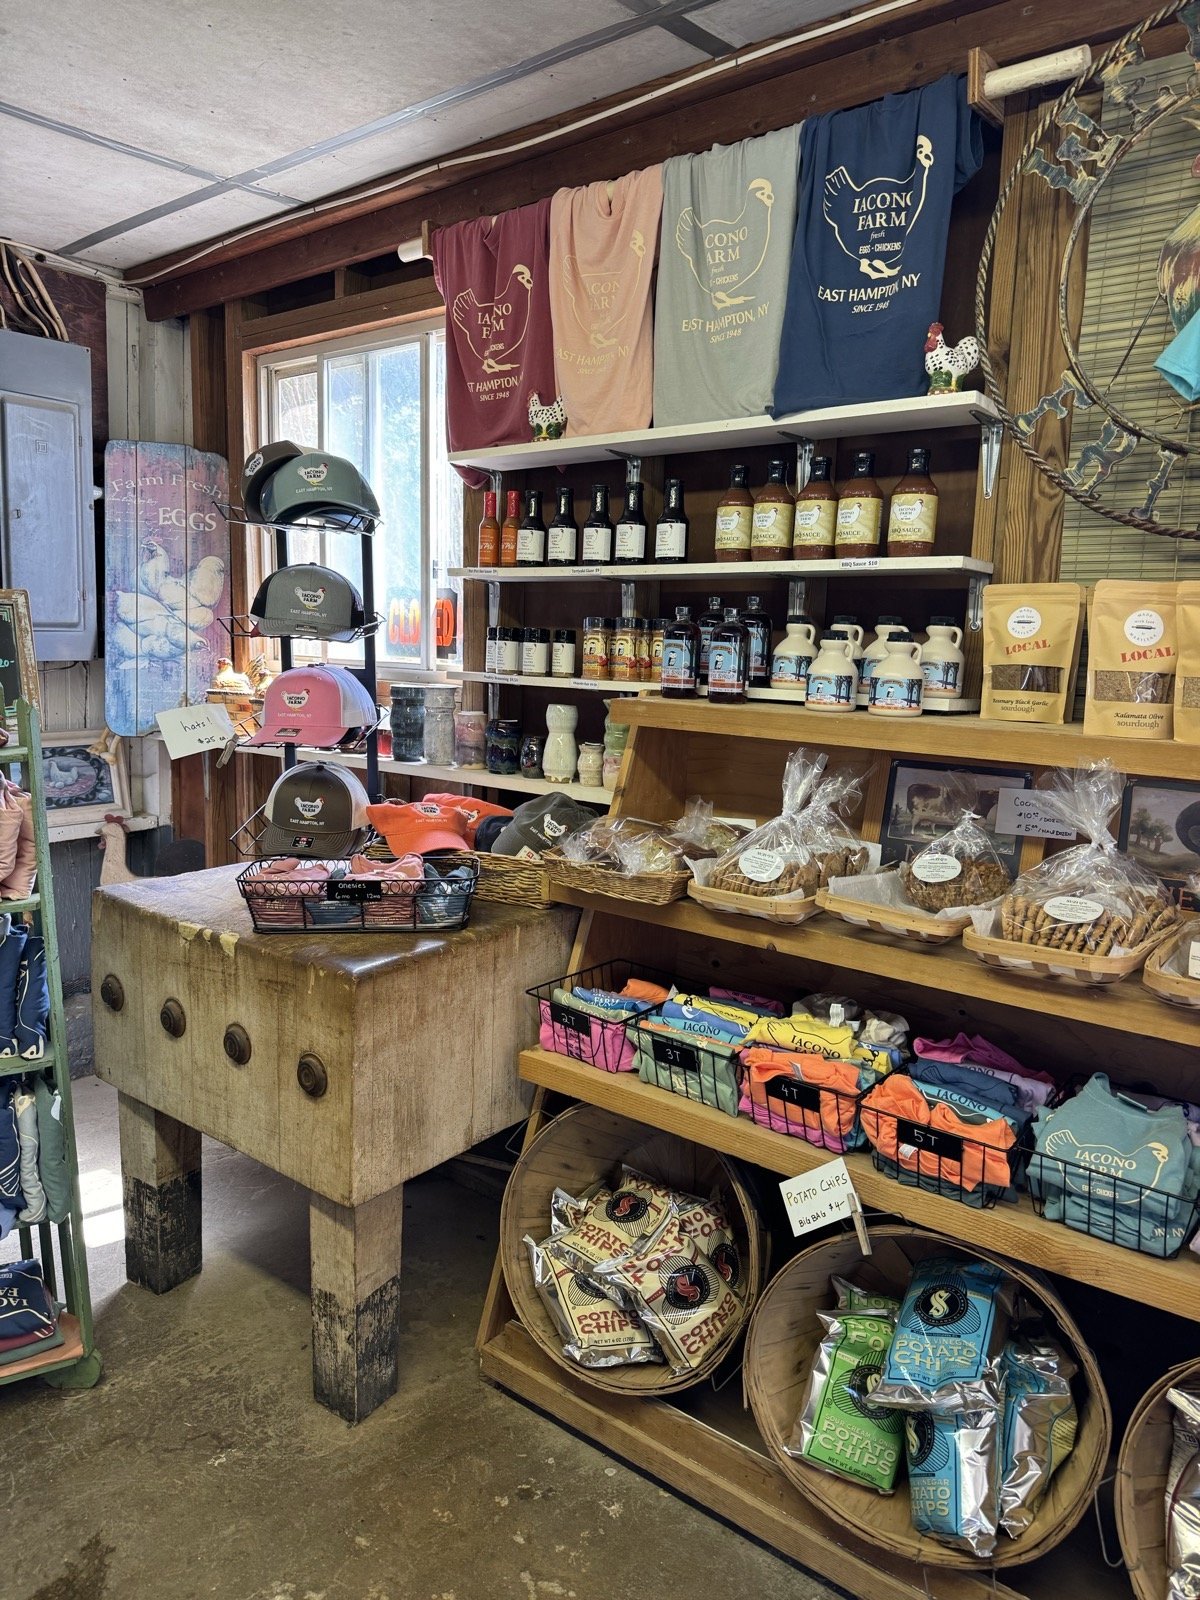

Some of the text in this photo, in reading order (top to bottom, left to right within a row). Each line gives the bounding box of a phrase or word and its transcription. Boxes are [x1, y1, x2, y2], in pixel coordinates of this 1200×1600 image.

[857, 211, 907, 231] FARM
[705, 226, 748, 249] CONO
[706, 246, 740, 266] ARM
[859, 241, 902, 254] EGGS CHICKENS
[817, 285, 847, 302] EAST
[902, 273, 921, 288] NY
[682, 318, 703, 332] EAST
[757, 302, 770, 317] NY
[852, 303, 874, 314] SINCE
[557, 348, 576, 362] AST
[496, 391, 510, 399] 1948
[111, 474, 223, 499] Farm Fresh
[158, 507, 217, 532] EGGS
[1004, 639, 1051, 656] LOCAL
[1120, 646, 1176, 663] LOCAL
[1001, 705, 1035, 713] sourdough
[1117, 720, 1160, 729] sourdough
[561, 1013, 576, 1026] 2T
[683, 1021, 721, 1037] IACONO
[665, 1048, 681, 1062] 3T
[791, 1034, 841, 1058] IACONO
[781, 1083, 798, 1100] 4T
[937, 1089, 988, 1112] IACONO
[913, 1129, 940, 1147] 5T
[1075, 1149, 1137, 1170] IACONO
[682, 1202, 724, 1229] NORT
[811, 1210, 827, 1223] BAG
[576, 1309, 640, 1325] POTATO
[679, 1292, 733, 1347] POTATO
[580, 1319, 642, 1335] CHIPS
[685, 1303, 737, 1355] CHIPS
[848, 1330, 885, 1352] FO
[895, 1340, 977, 1358] POTATO
[825, 1413, 845, 1427] SOUR
[847, 1423, 871, 1438] CREAM
[822, 1420, 896, 1463] POTATO
[818, 1433, 892, 1476] CHIPS
[828, 1456, 838, 1464] NET
[839, 1460, 848, 1468] WT
[912, 1485, 951, 1499] OTATO
[911, 1500, 949, 1516] HIPS
